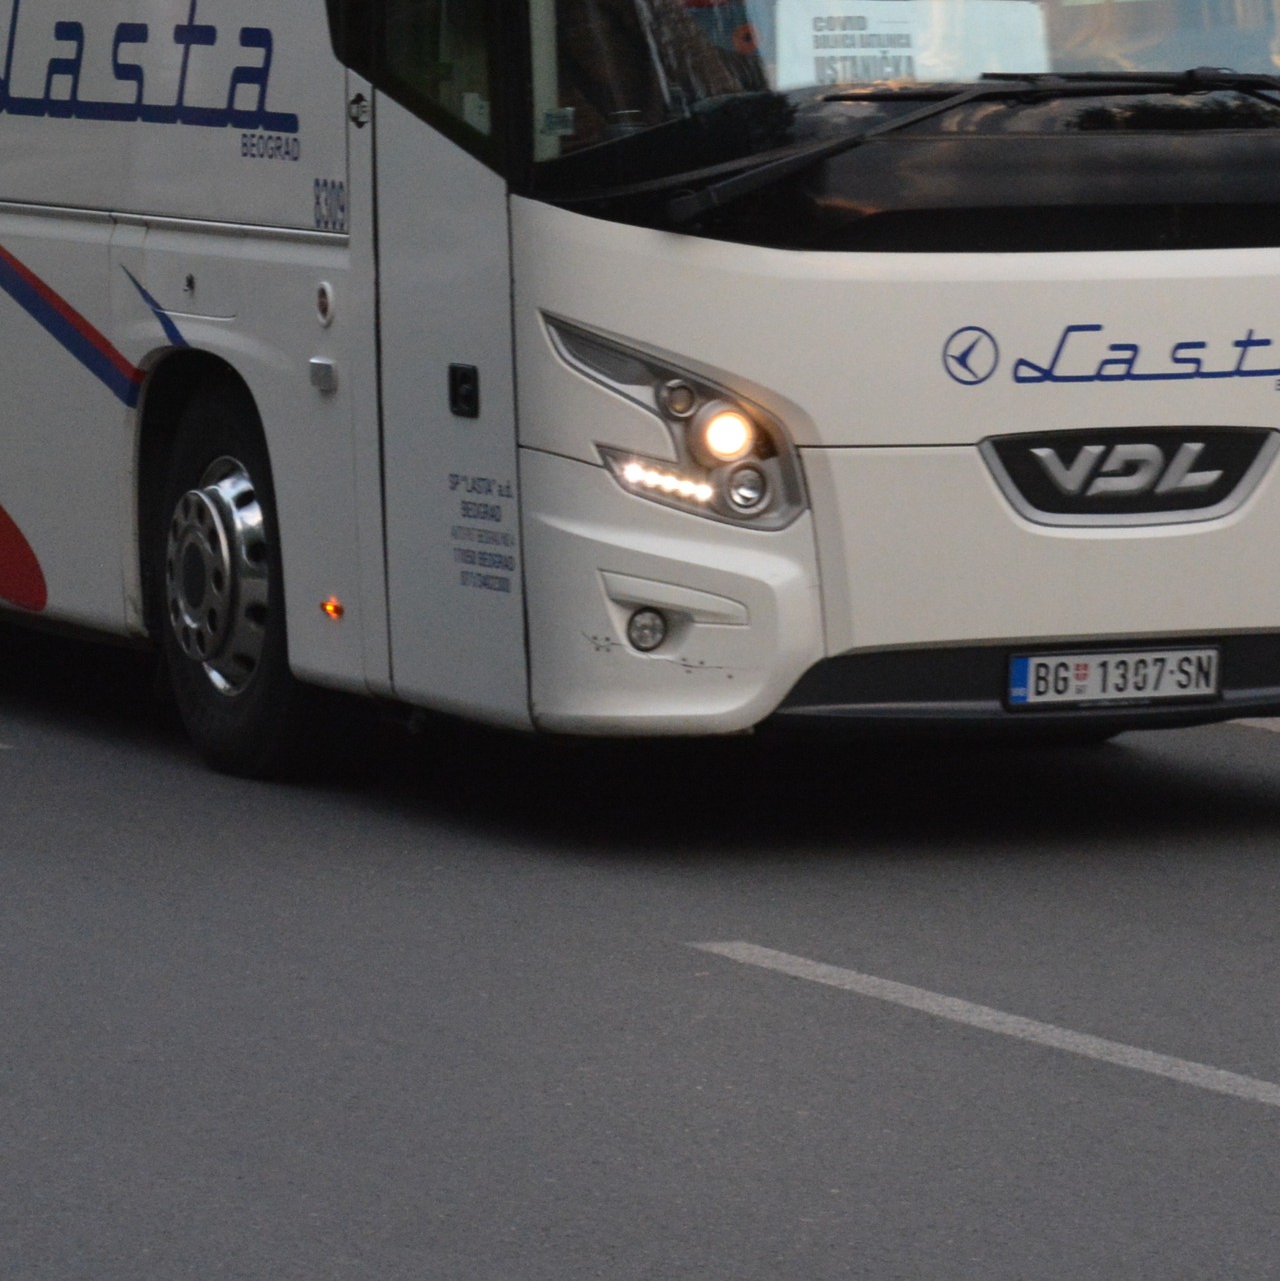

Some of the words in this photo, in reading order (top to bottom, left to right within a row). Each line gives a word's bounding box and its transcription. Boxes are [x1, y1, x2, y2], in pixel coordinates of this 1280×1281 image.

[813, 16, 868, 31] COVID
[240, 133, 300, 162] BEOGRAD
[1028, 442, 1225, 497] VDL
[1034, 661, 1070, 697] BG
